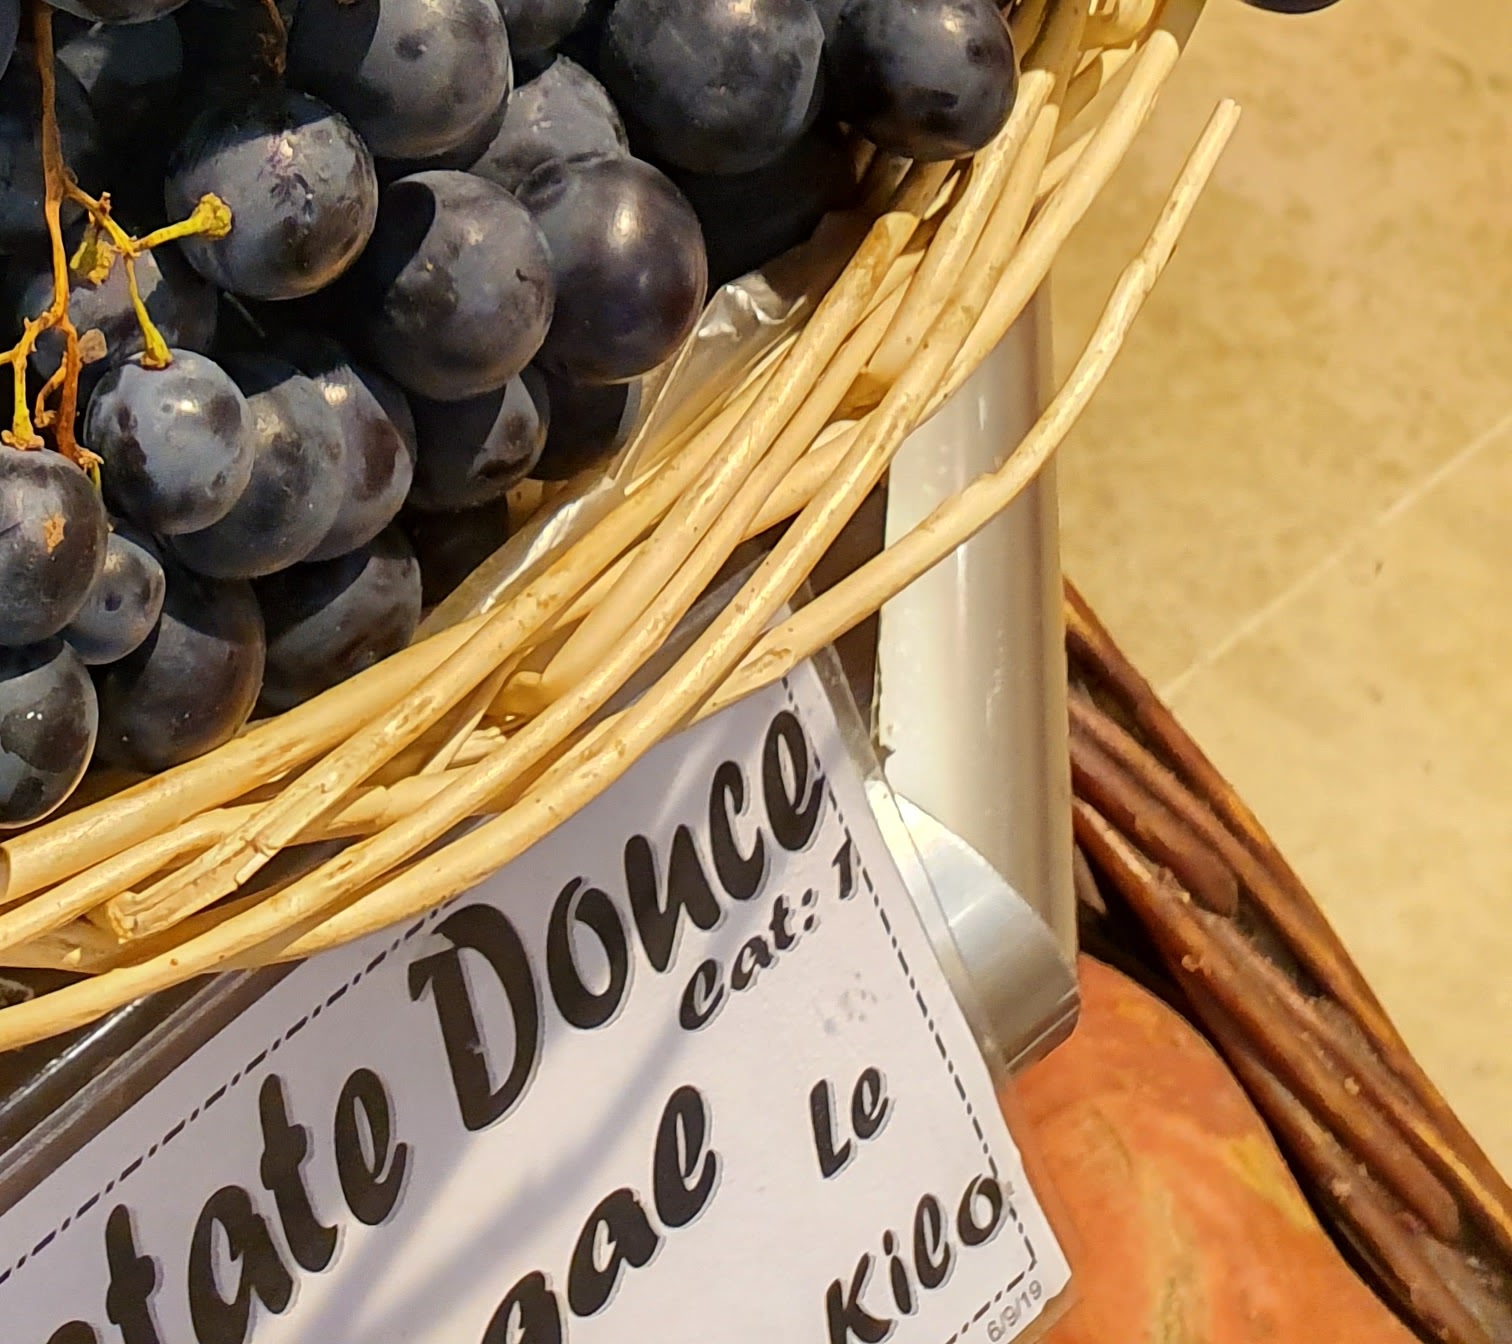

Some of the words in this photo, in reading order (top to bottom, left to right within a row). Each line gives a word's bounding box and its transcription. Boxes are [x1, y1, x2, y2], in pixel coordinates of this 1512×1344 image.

[408, 710, 828, 1132] Douce
[808, 1066, 894, 1180] Le
[825, 1174, 1006, 1344] Kilo
[987, 1280, 1043, 1343] 6/9/19
